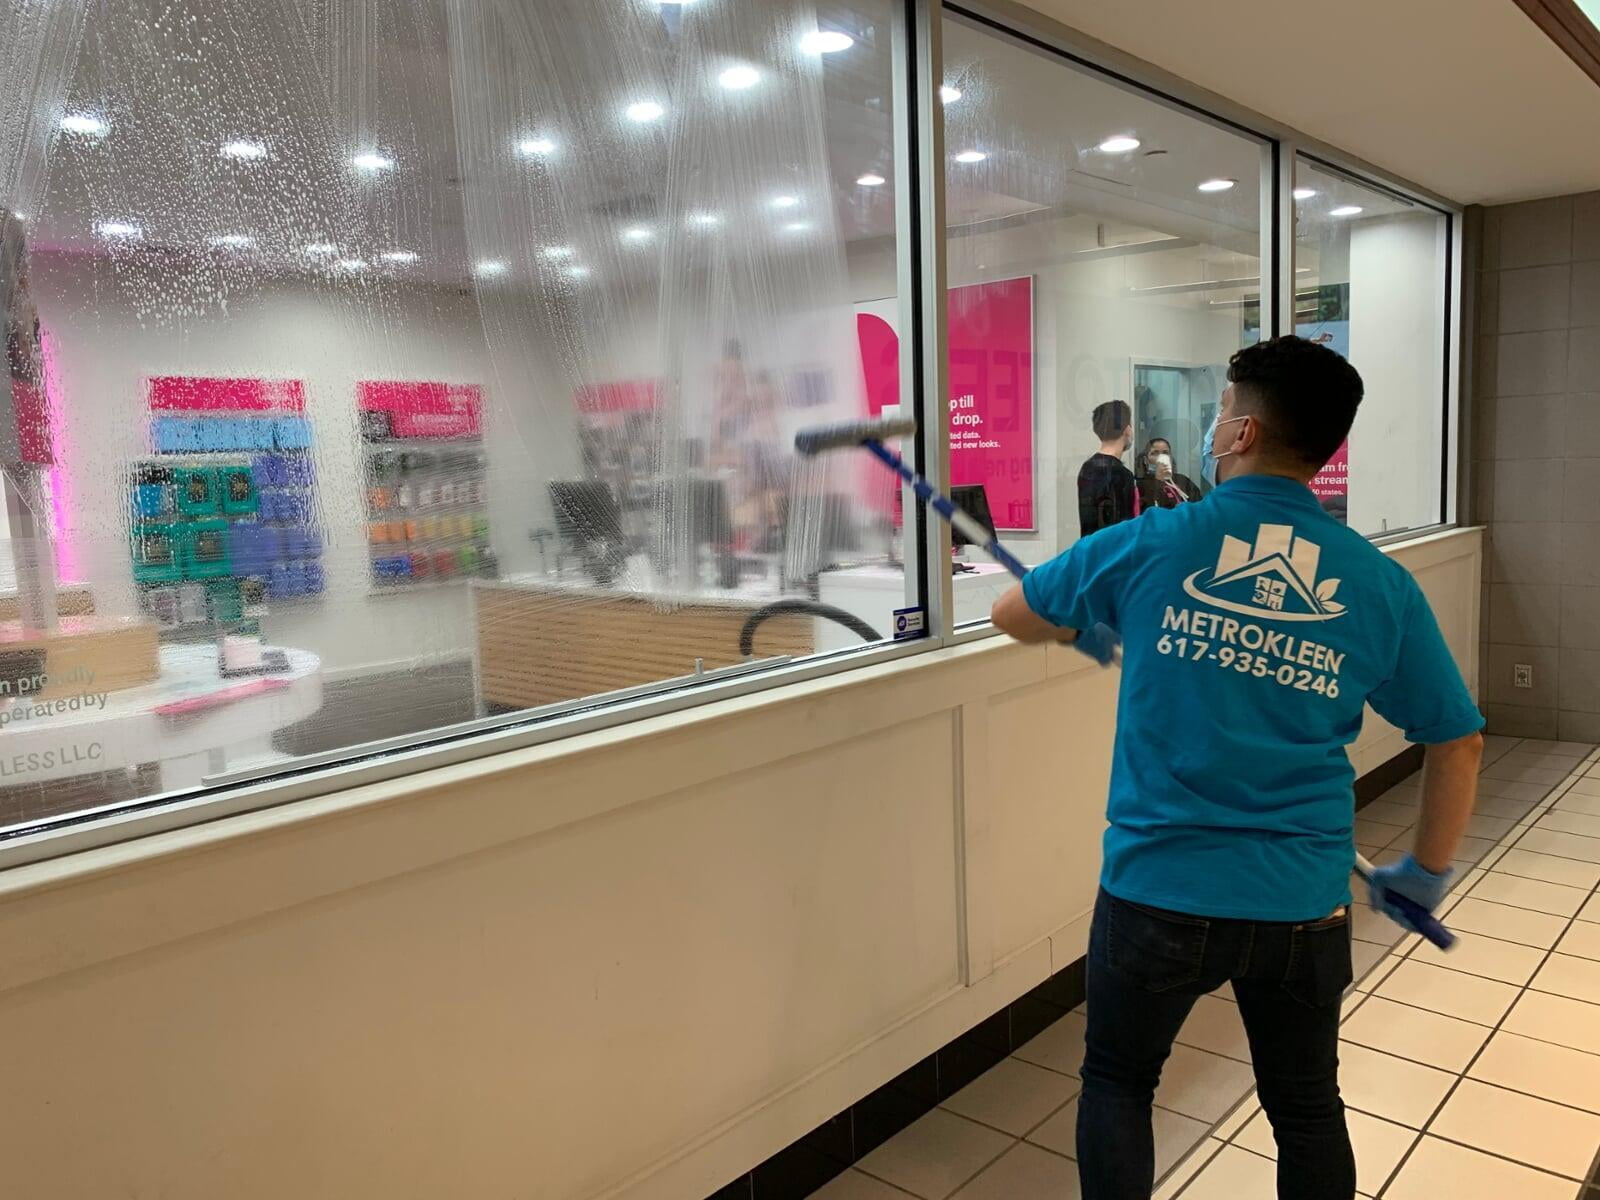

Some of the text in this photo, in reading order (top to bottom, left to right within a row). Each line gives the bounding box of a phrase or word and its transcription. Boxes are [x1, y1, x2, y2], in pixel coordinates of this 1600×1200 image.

[959, 394, 974, 408] till
[952, 412, 983, 427] drop.
[962, 431, 981, 440] data.
[979, 440, 1000, 449] looks.
[1161, 605, 1346, 675] METROKLEEN
[1157, 634, 1339, 698] 617-935-0246
[60, 742, 102, 765] LLC
